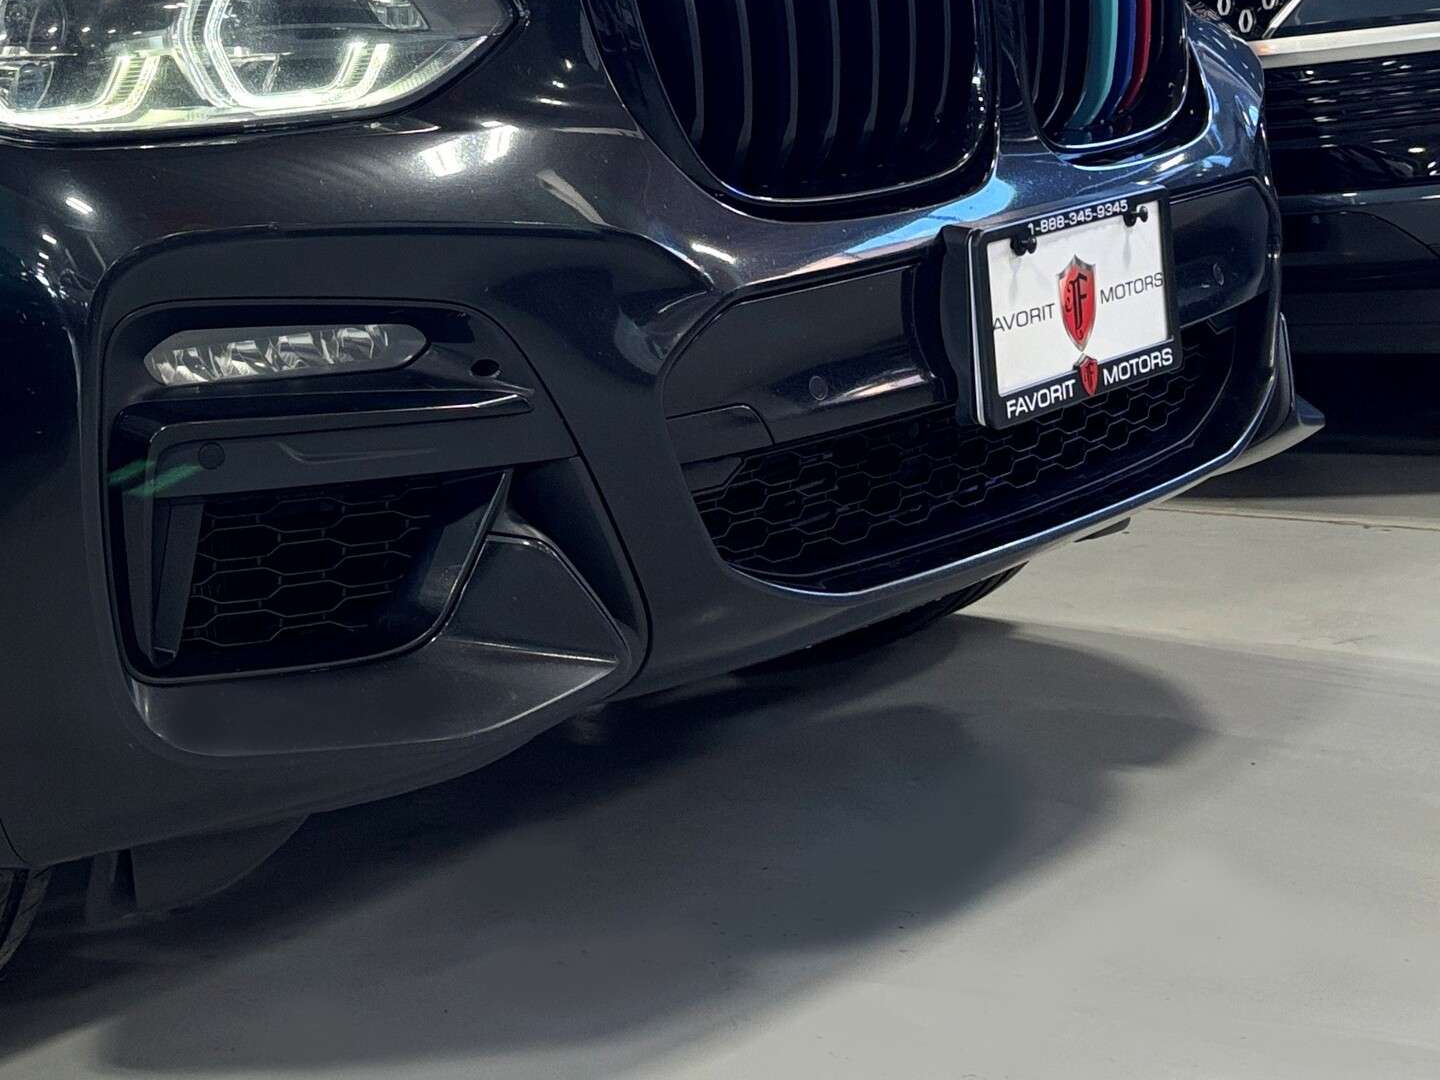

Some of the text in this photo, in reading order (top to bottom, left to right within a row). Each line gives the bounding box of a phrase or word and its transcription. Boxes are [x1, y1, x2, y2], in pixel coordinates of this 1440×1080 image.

[1028, 199, 1129, 236] 1-888-345-9345
[993, 302, 1056, 333] AVORIT
[1100, 271, 1165, 305] MOTORS
[1005, 378, 1077, 419] FAVORIT
[1102, 347, 1174, 386] MOTORS
